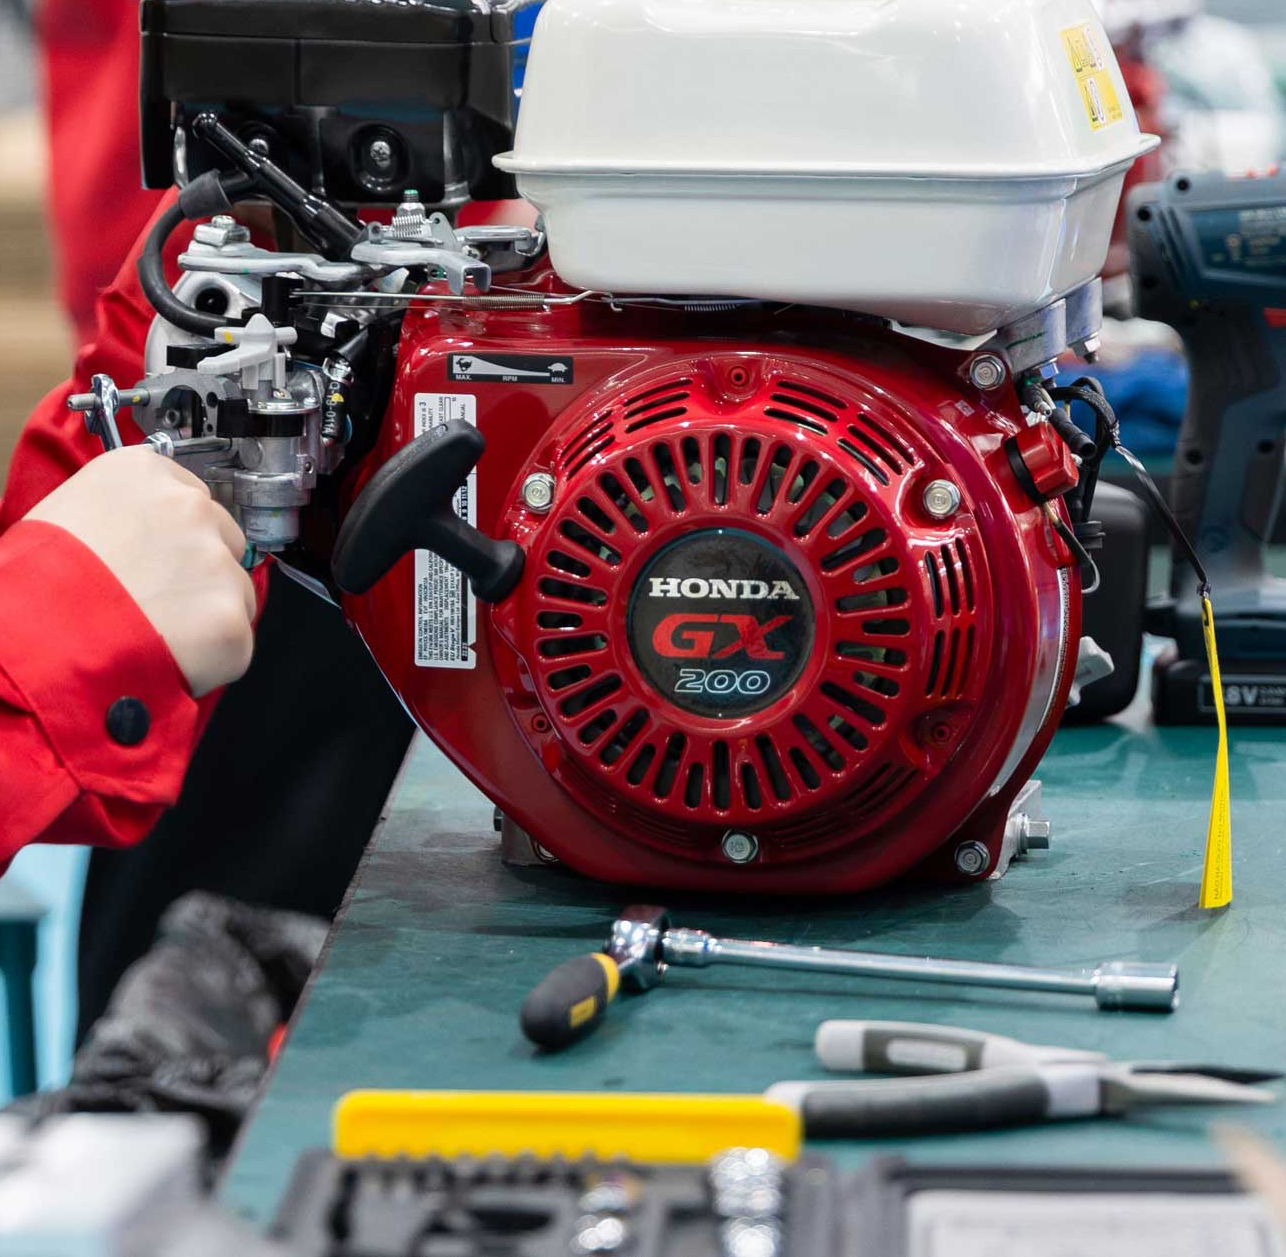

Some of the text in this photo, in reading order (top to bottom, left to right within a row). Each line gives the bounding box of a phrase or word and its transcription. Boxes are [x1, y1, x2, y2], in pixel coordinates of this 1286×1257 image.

[649, 577, 800, 600] HONDA
[652, 613, 794, 660] GX
[674, 668, 770, 694] 200
